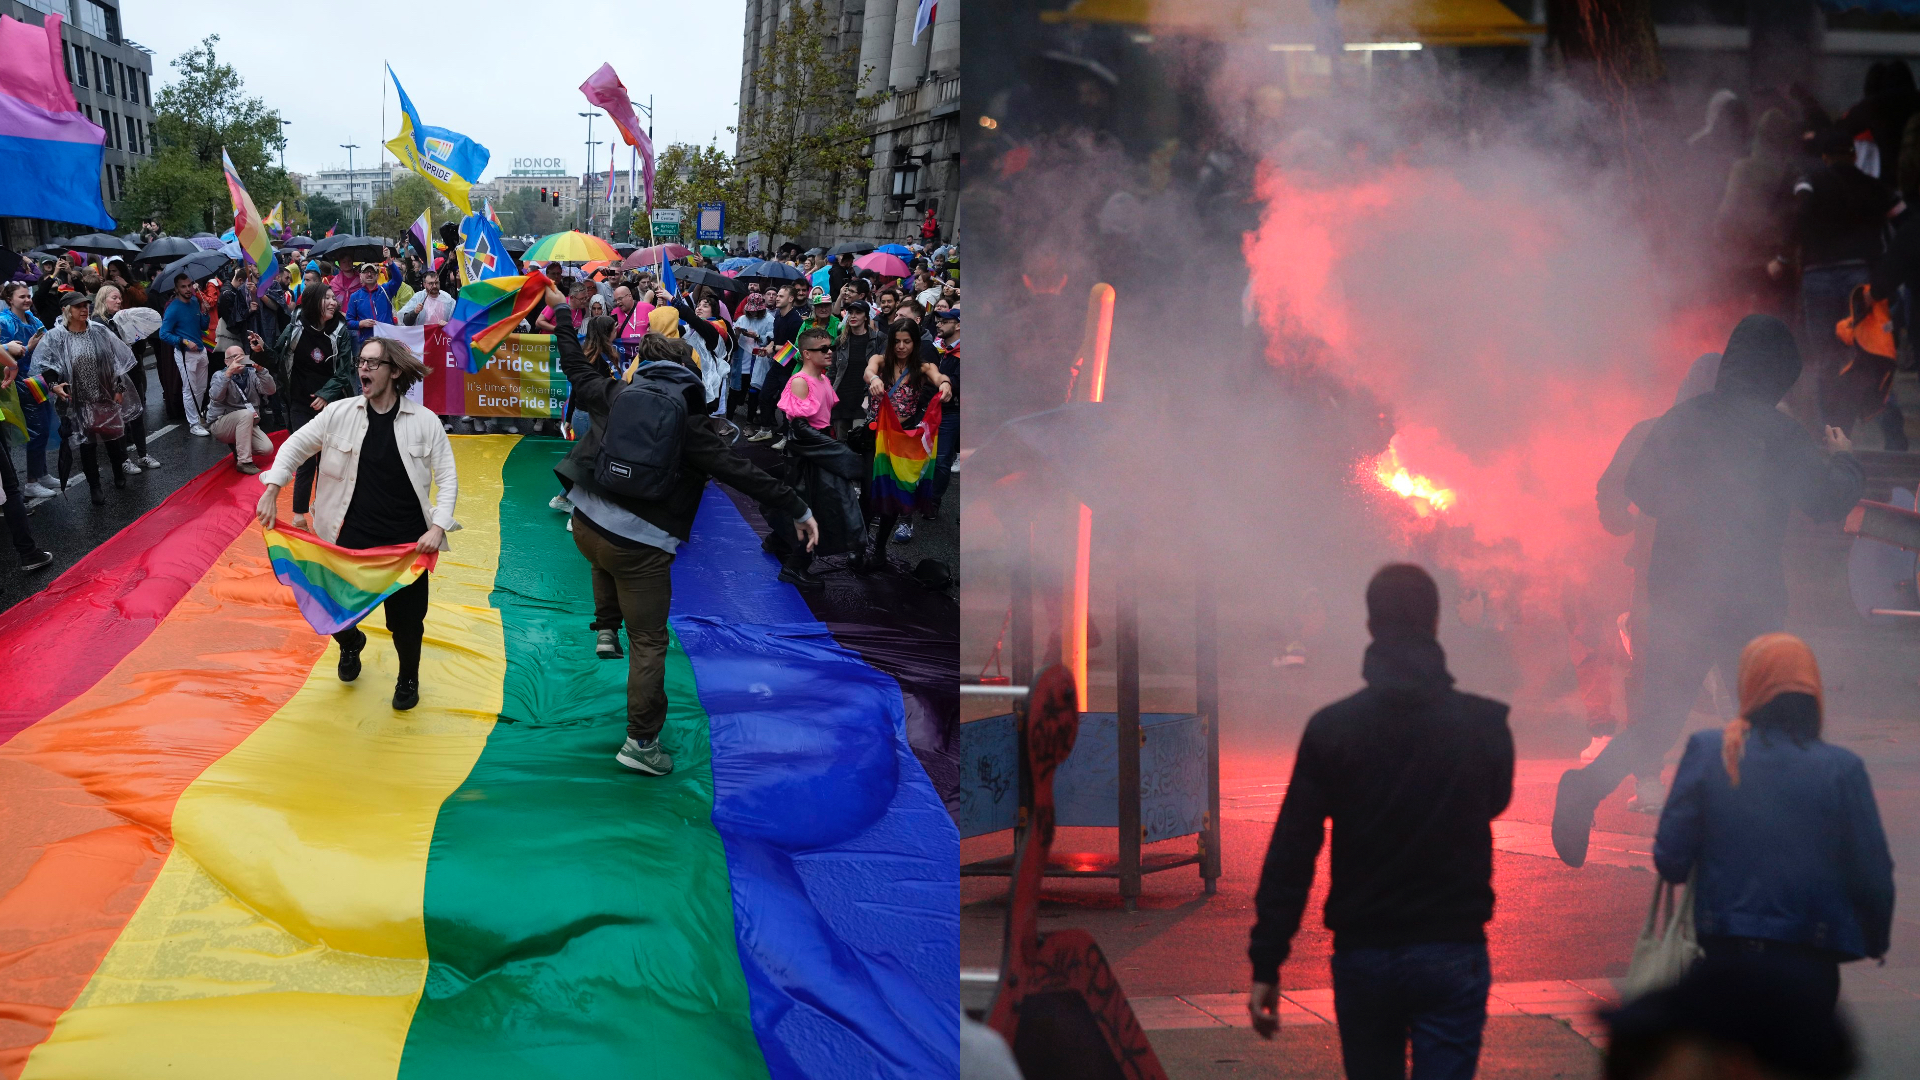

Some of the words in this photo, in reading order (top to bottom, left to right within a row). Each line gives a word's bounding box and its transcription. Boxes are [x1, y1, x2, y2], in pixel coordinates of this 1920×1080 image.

[514, 157, 561, 168] HONOR
[433, 333, 452, 346] Vre
[512, 343, 558, 354] prome
[538, 361, 550, 373] u
[467, 381, 482, 391] It's
[484, 382, 507, 393] time
[509, 383, 522, 393] for
[526, 384, 566, 397] change.
[478, 394, 546, 409] EuroPride
